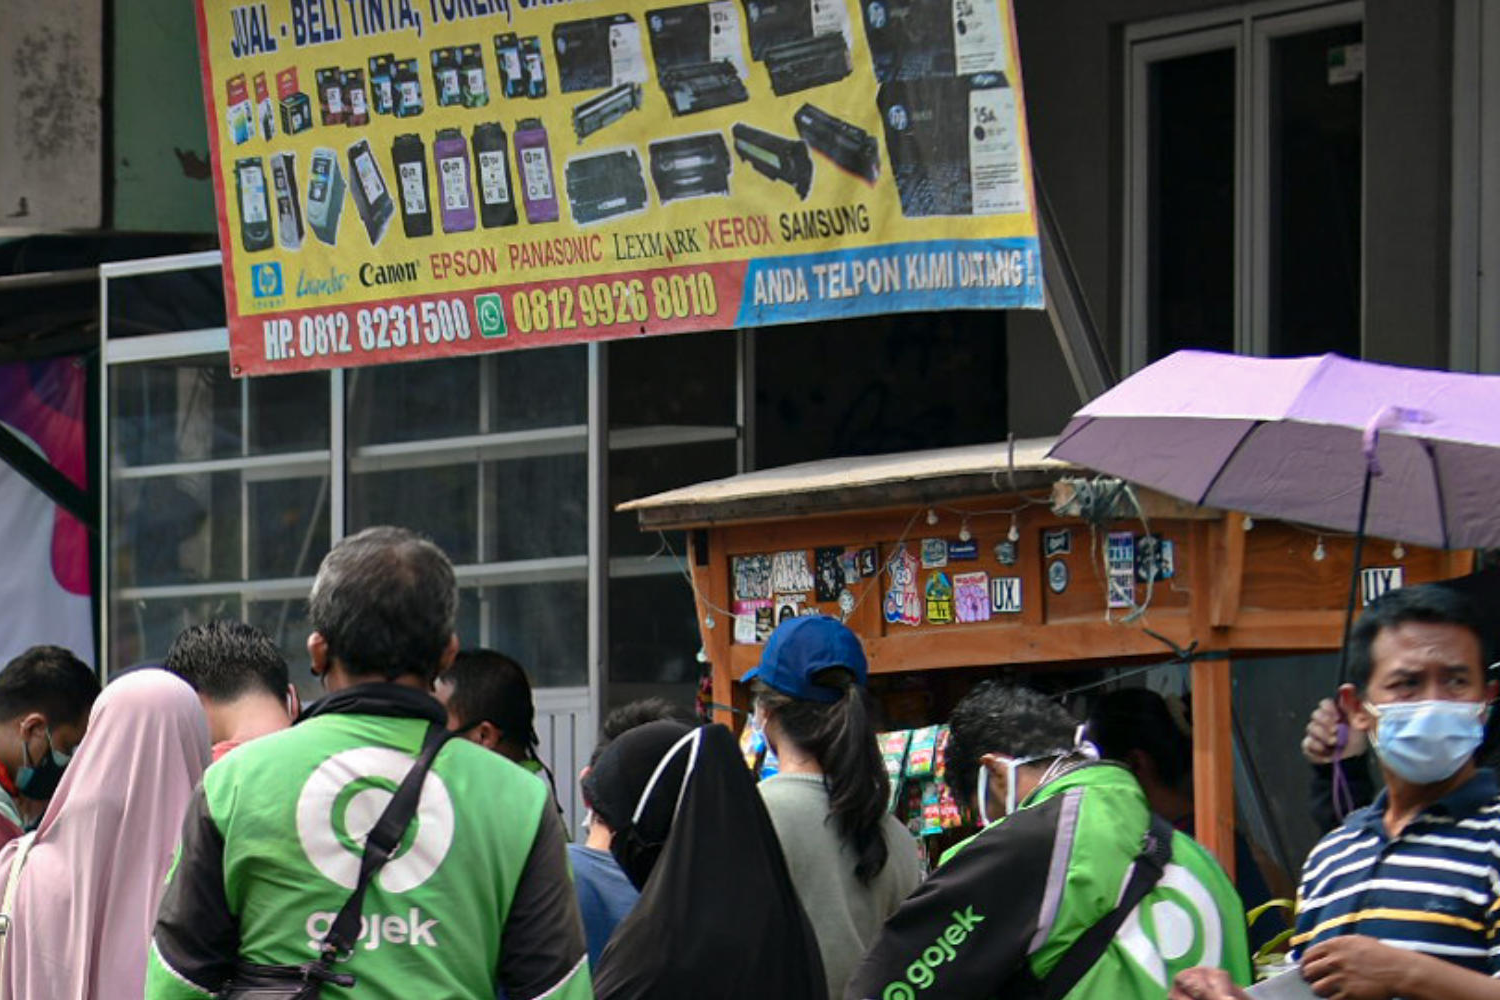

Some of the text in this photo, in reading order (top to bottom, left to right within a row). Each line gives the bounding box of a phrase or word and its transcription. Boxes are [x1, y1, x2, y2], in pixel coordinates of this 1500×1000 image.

[230, 4, 277, 58] JUAL
[291, 0, 342, 46] BELI
[429, 248, 497, 280] EPSON
[508, 234, 604, 271] PANASONIC
[612, 227, 701, 261] LEXMARK
[705, 214, 774, 249] XEROX
[779, 204, 870, 242] SAMSUNG
[512, 286, 577, 333] 0812
[651, 271, 718, 320] 8010
[753, 266, 810, 306] ANDA
[812, 255, 901, 299] TELPON
[905, 250, 954, 290] KAMI
[957, 249, 1025, 288] DATANG
[305, 907, 440, 953] gjek
[906, 904, 986, 990] gojek
